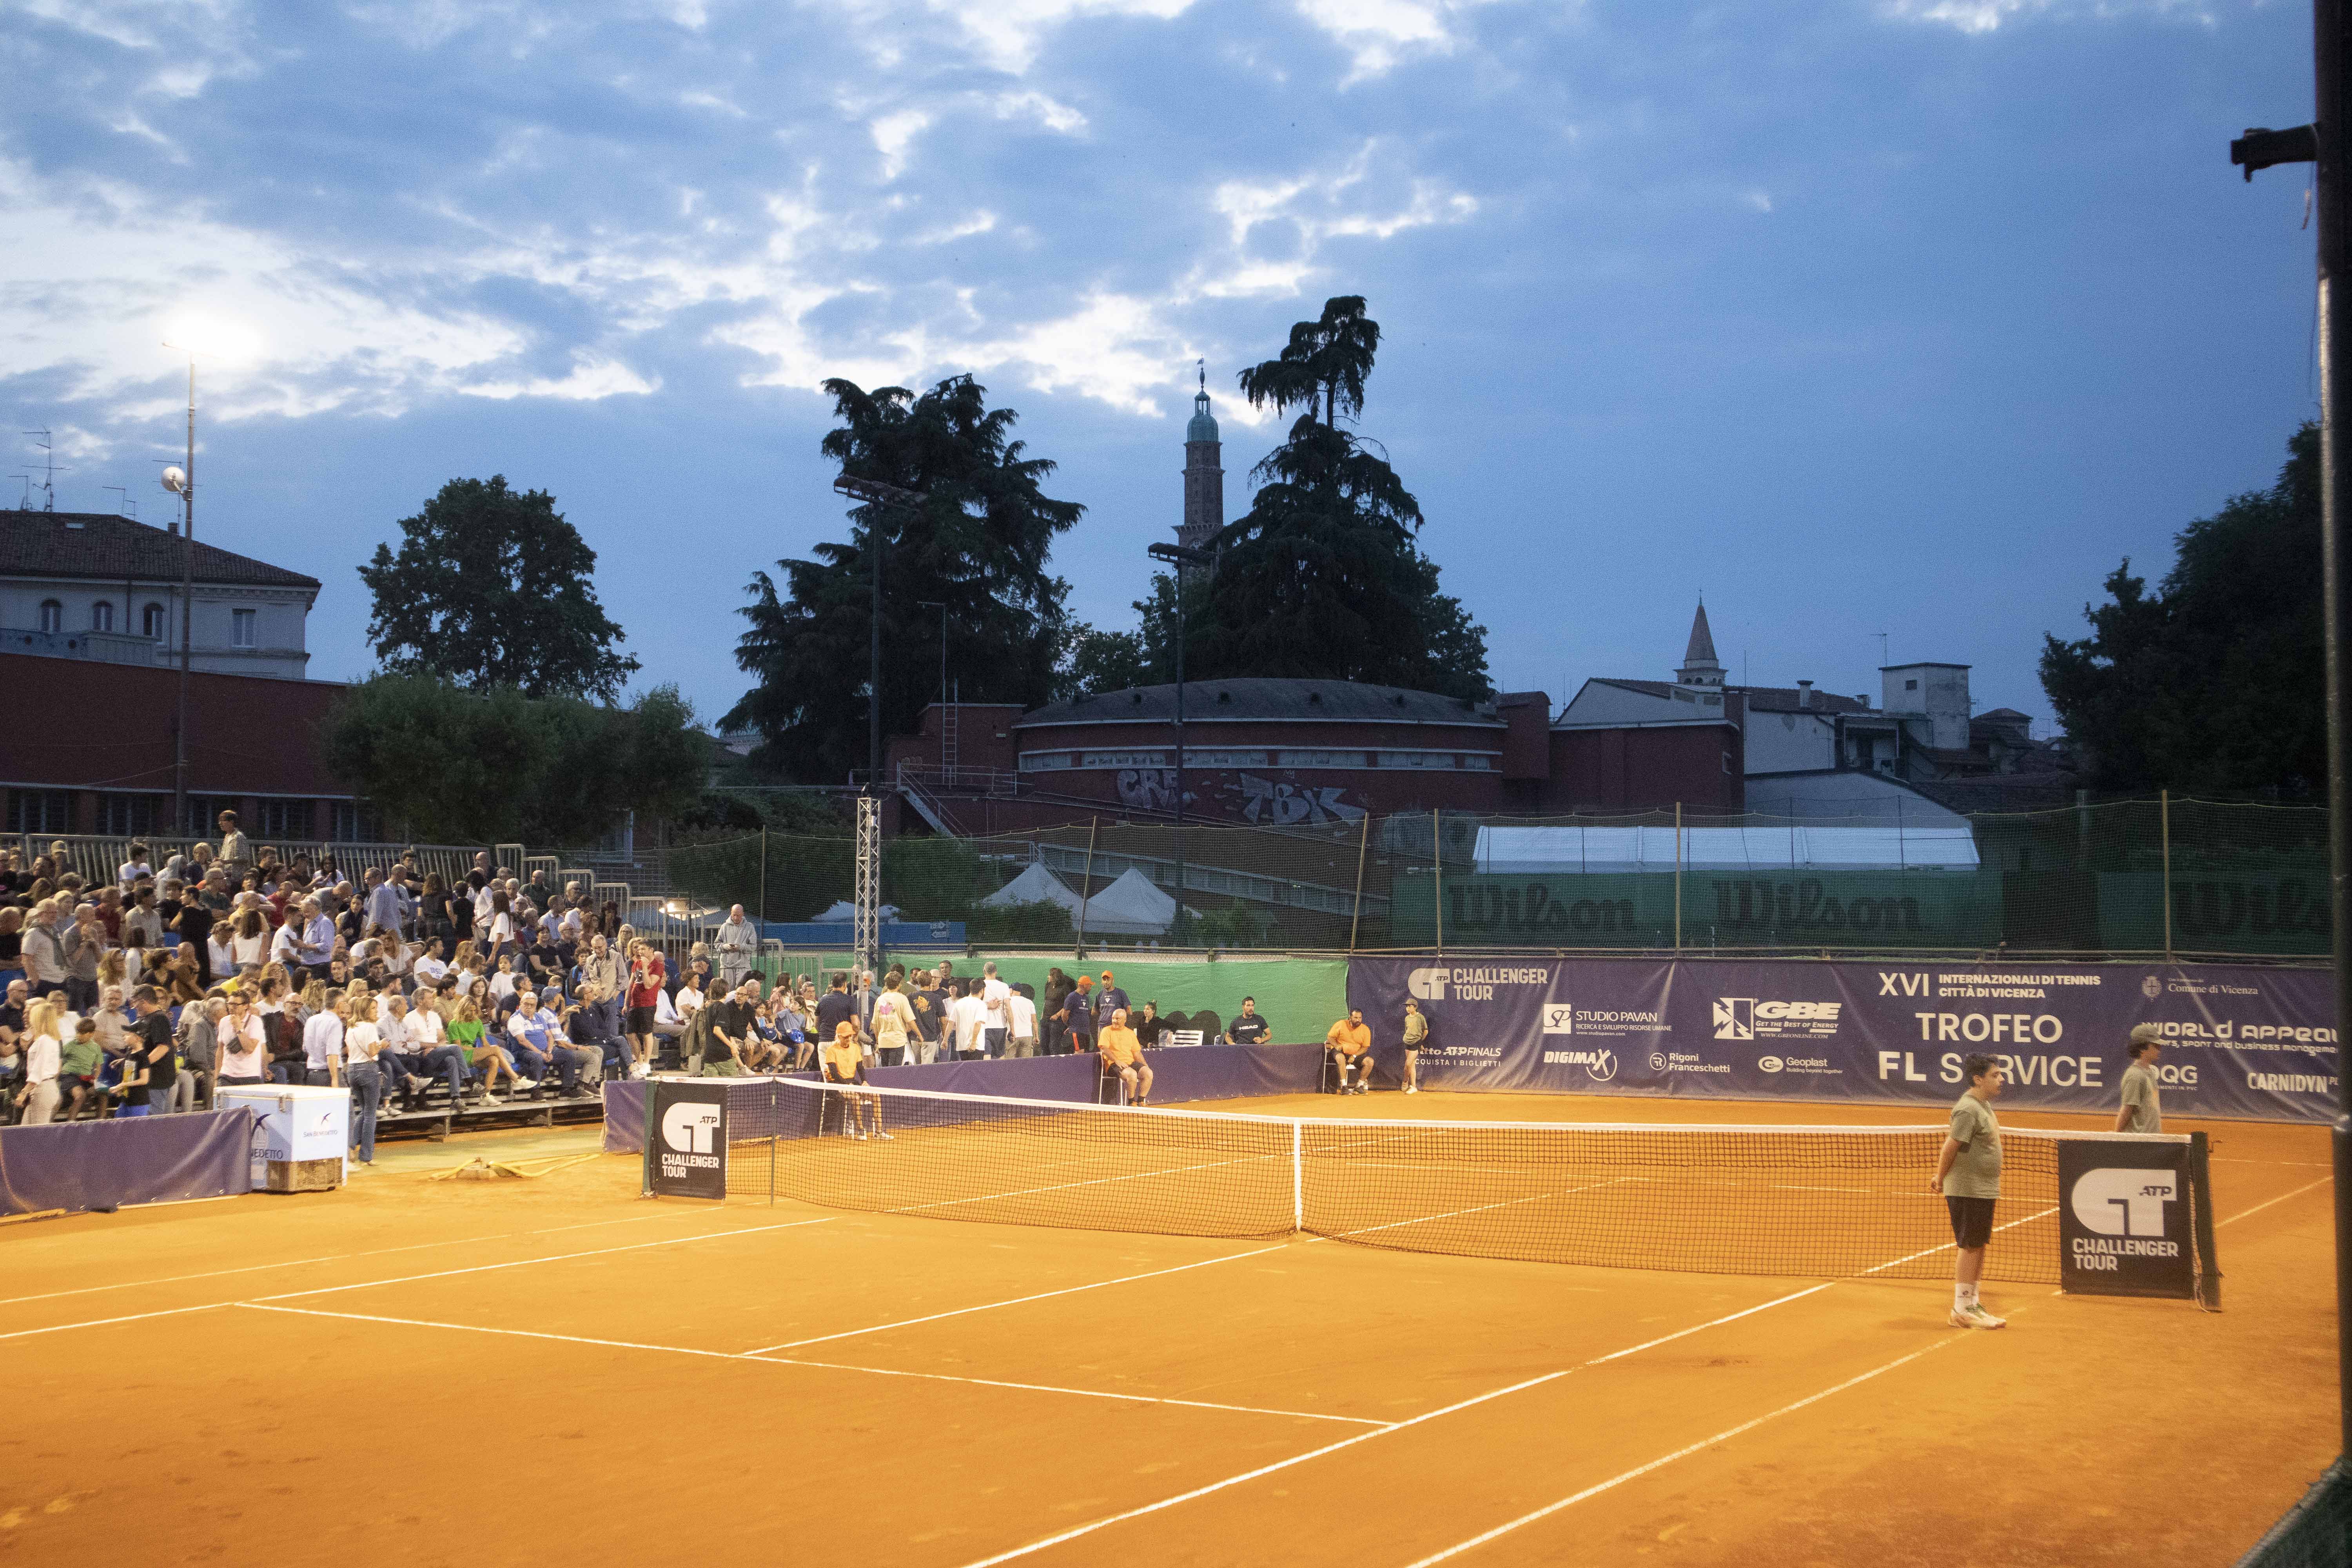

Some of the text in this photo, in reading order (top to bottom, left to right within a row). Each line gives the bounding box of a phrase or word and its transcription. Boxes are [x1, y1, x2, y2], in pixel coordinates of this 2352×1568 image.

[1448, 883, 1636, 931] Wilson
[1712, 878, 1924, 932] Wilson
[1453, 968, 1548, 984] CHALLENGER
[1938, 974, 2102, 985] INTERNAZIONALI DI TENNIS
[1878, 973, 1929, 996] XVI
[1939, 985, 2046, 998] CITTÀ DI VICENZA
[2168, 983, 2259, 994] Comune di Vicenza
[1454, 985, 1493, 1000] TOUR
[1576, 1011, 1657, 1022] STUDIO PAVAN
[1755, 1001, 1842, 1020] GBE
[1915, 1013, 2063, 1043] TROFEO
[1467, 1047, 1501, 1057] FINALS
[1669, 1053, 1699, 1062] Rigoni
[2283, 1044, 2338, 1056] manageme
[1544, 1049, 1611, 1076] DIGIMAX
[1669, 1063, 1730, 1073] Franceschetti
[1786, 1057, 1828, 1067] Geoplast
[1878, 1051, 2103, 1087] FL SRVICE
[2247, 1072, 2327, 1093] CARNIDYN
[700, 1116, 717, 1124] ATP
[662, 1153, 719, 1169] CHALLENGER
[662, 1165, 686, 1178] TOUR
[2139, 1185, 2172, 1196] ATP
[2073, 1238, 2179, 1257] CHALLENGER
[2073, 1254, 2118, 1271] TOUR
